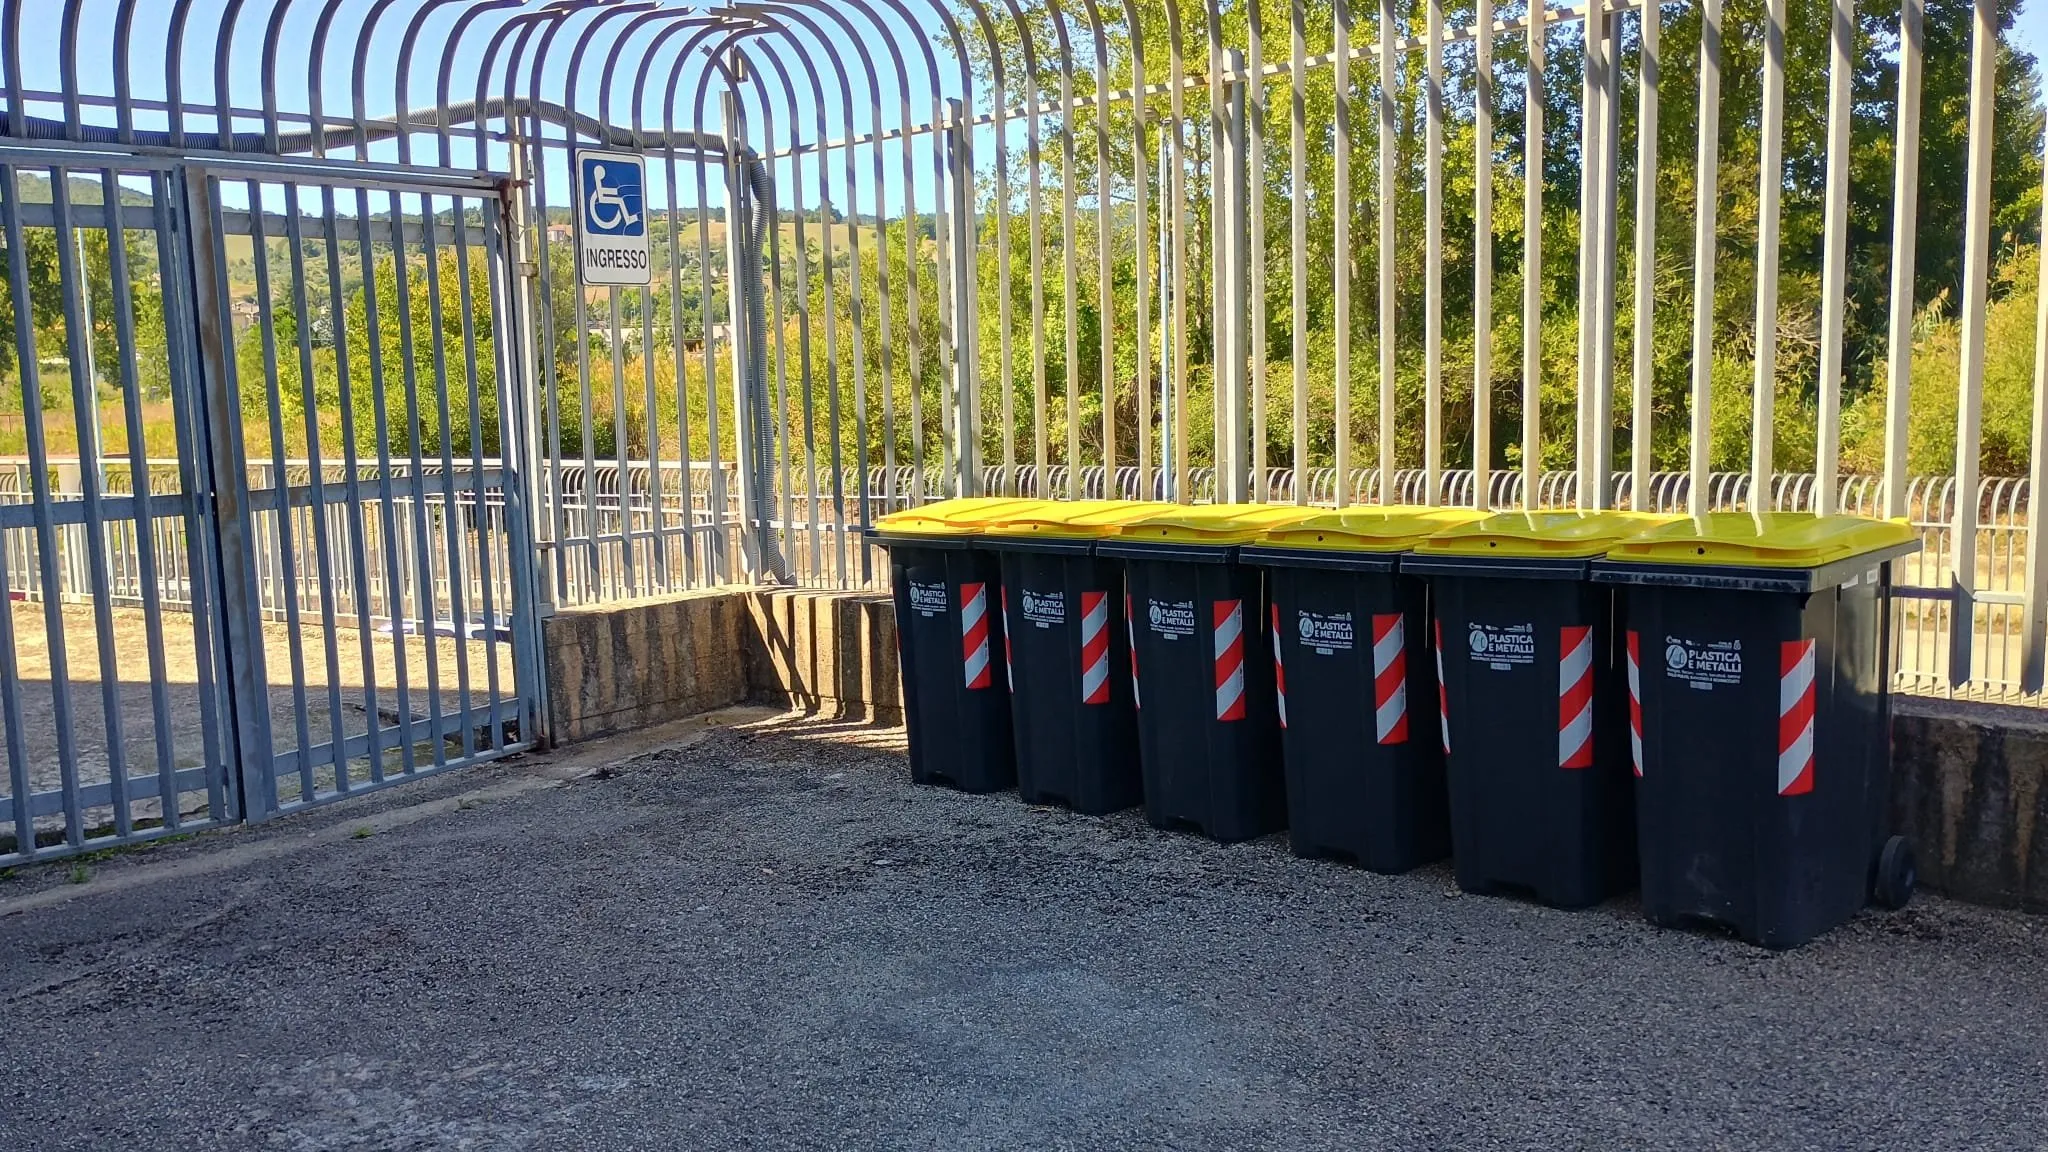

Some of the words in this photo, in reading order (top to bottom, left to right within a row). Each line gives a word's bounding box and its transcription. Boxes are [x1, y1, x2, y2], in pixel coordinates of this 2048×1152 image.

[586, 248, 647, 269] INGRESSO
[920, 590, 946, 598] PLASTICA
[1035, 599, 1064, 608] PLASTICA
[1162, 609, 1194, 618] PLASTICA
[1167, 618, 1194, 626] METALLI
[1315, 621, 1352, 631] PLASTICA
[1320, 630, 1352, 639] METALLI
[1489, 634, 1533, 643] PLASTICA
[1489, 643, 1494, 651] E
[1496, 644, 1534, 653] METALLI
[1688, 650, 1741, 662] PLASTICA
[1688, 660, 1694, 669] E
[1696, 660, 1741, 672] METALLI
